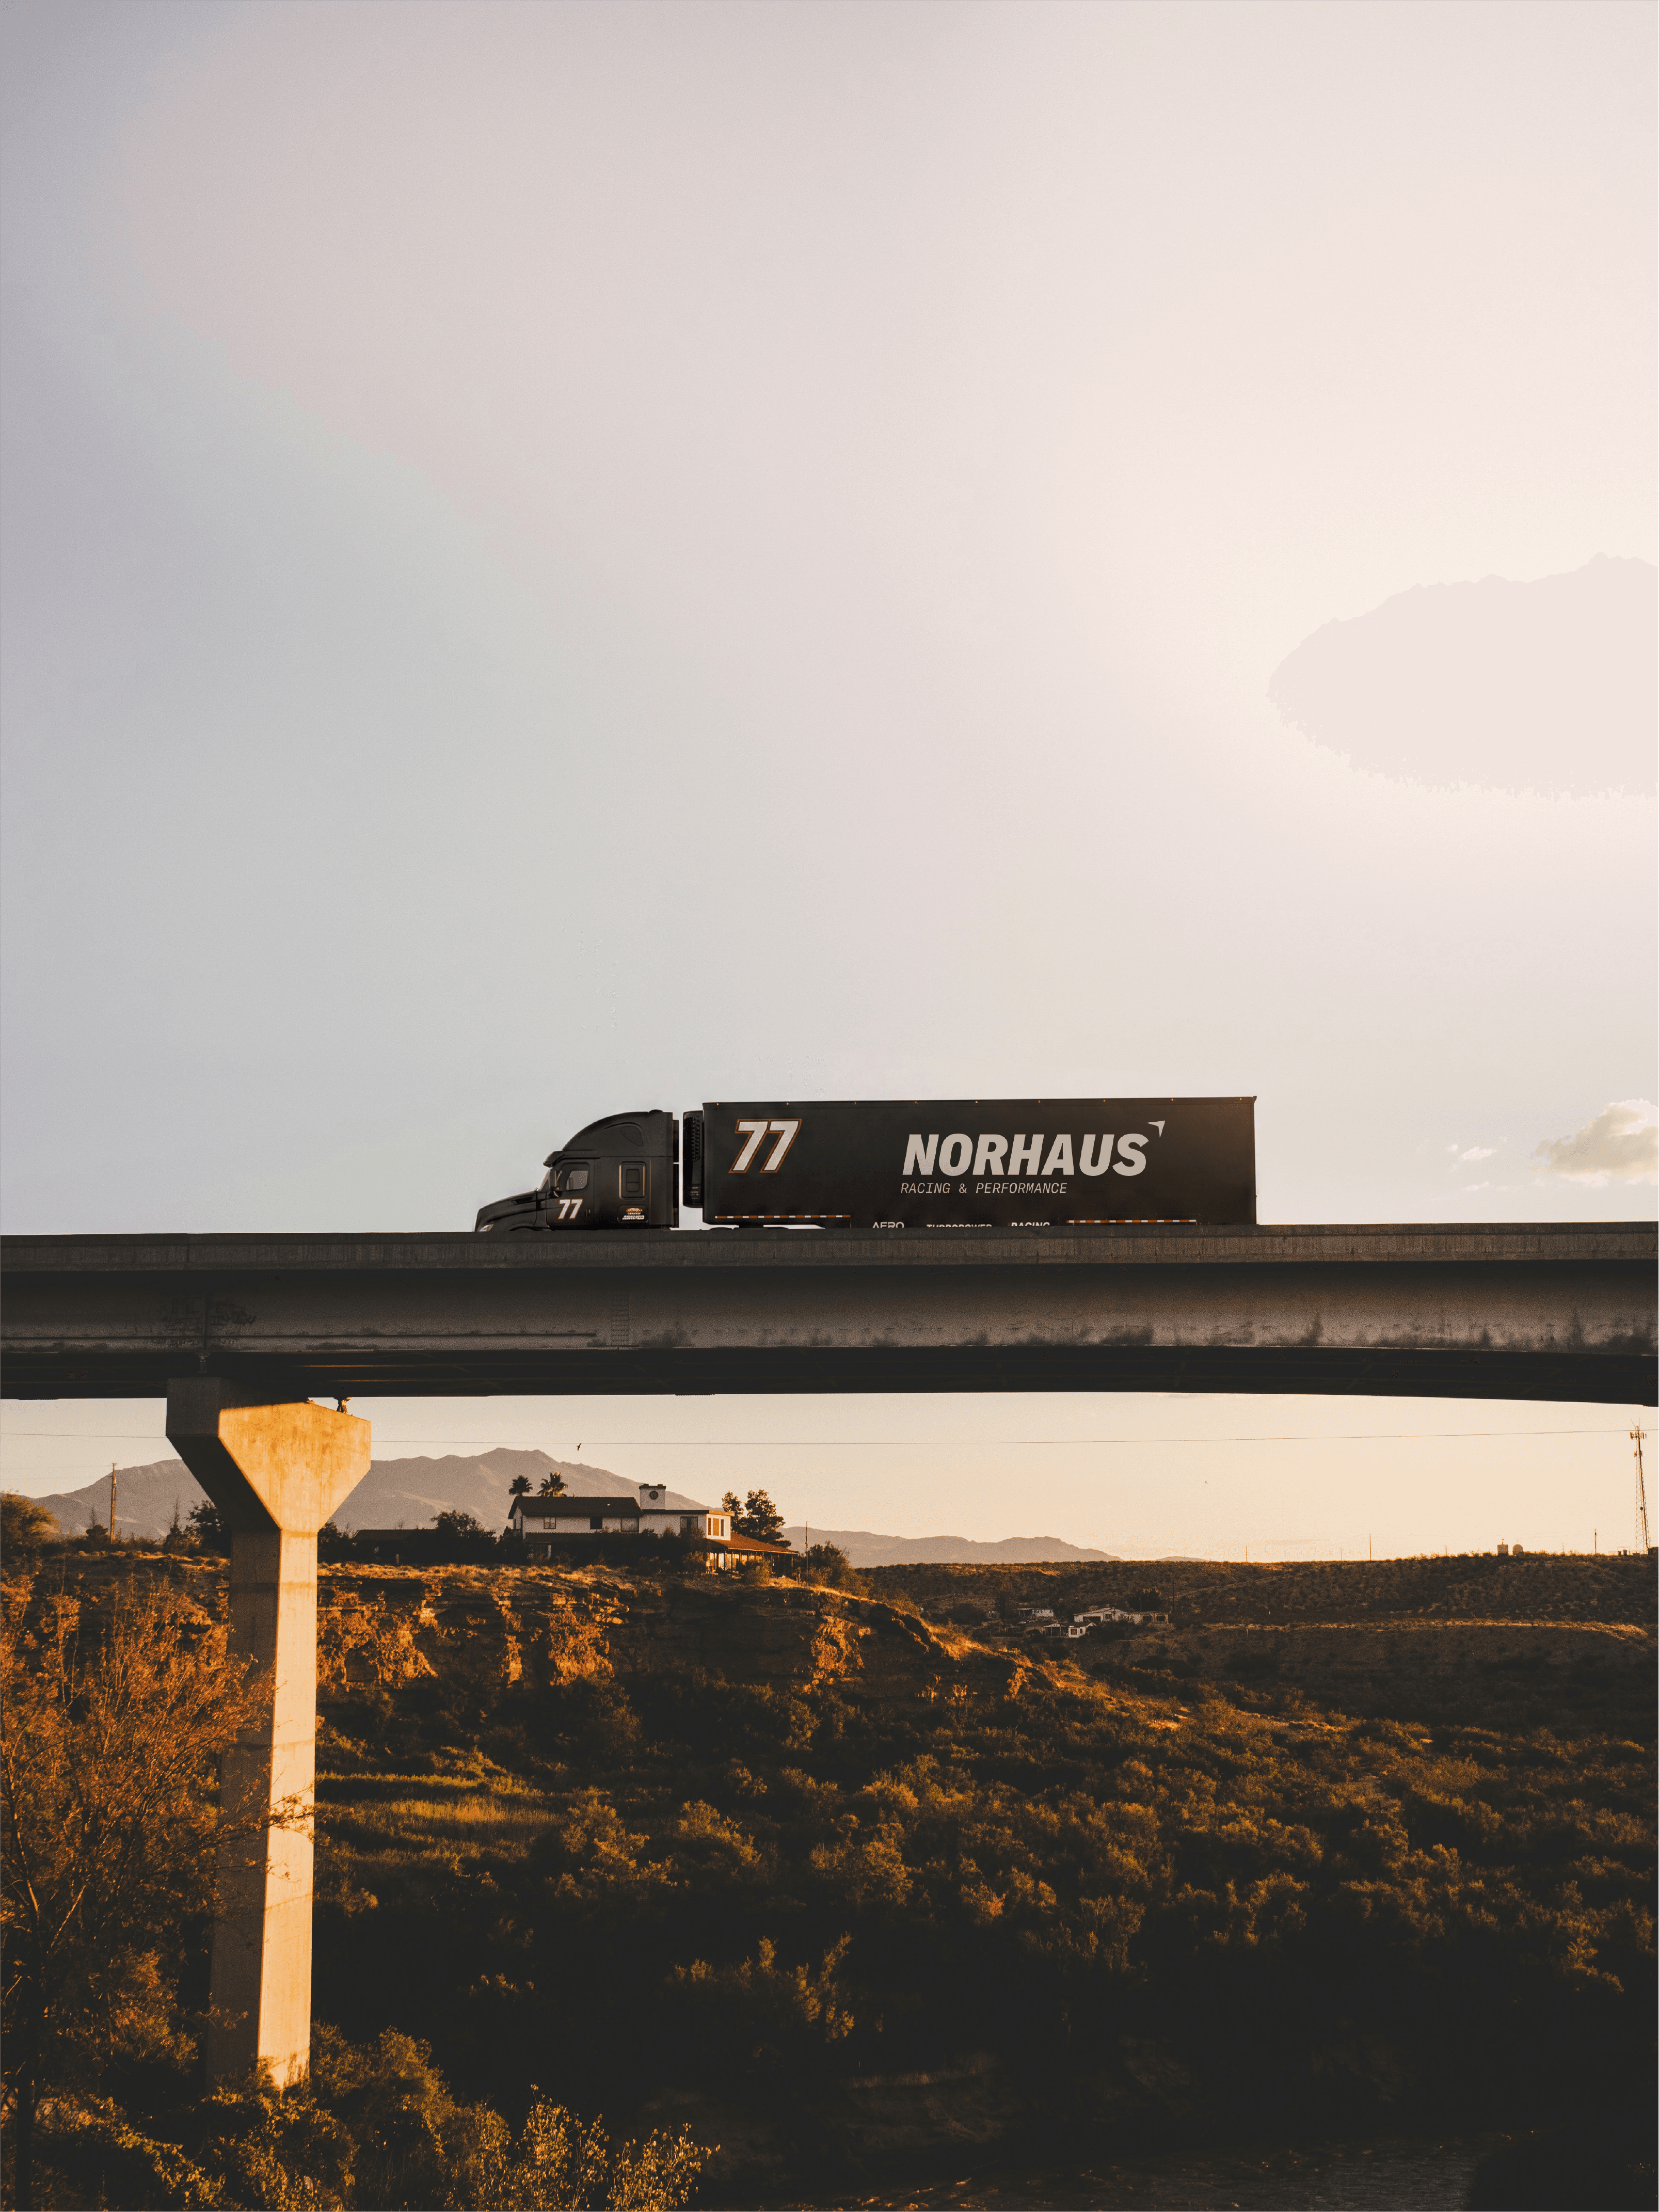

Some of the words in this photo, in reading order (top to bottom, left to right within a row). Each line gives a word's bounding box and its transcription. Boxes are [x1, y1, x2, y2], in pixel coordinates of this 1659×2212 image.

[728, 1119, 802, 1173] 77
[902, 1133, 1150, 1176] NORHAUS
[901, 1183, 950, 1193] RACING
[959, 1183, 967, 1193] &
[976, 1183, 1067, 1193] PERFORMANCE
[558, 1199, 583, 1219] 77
